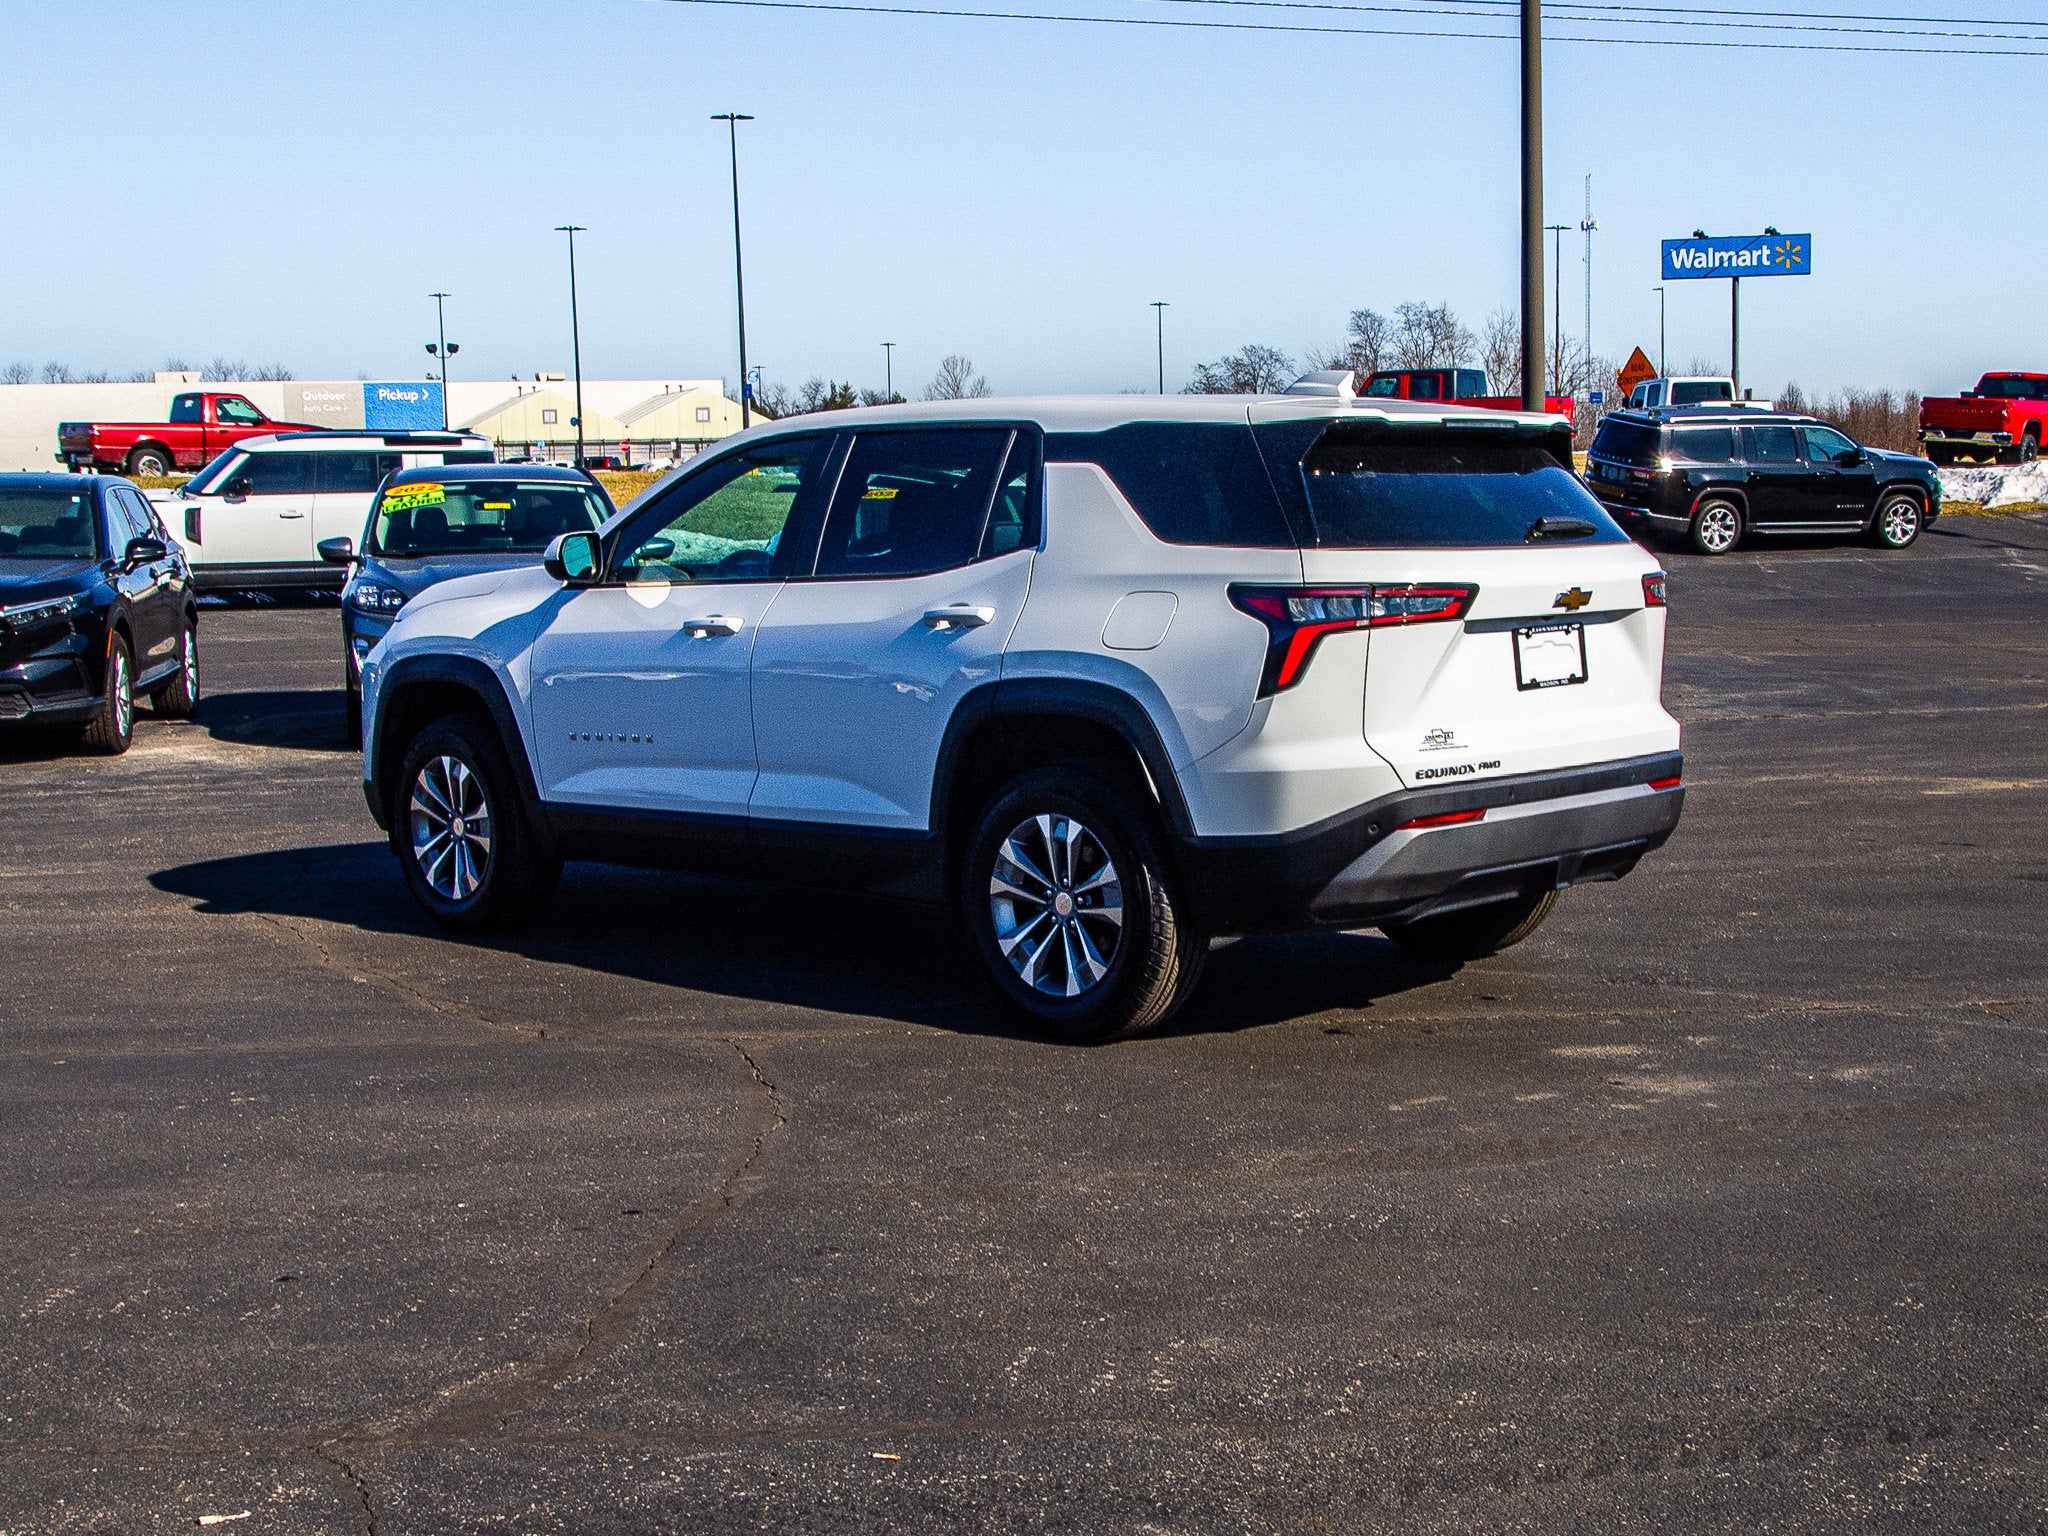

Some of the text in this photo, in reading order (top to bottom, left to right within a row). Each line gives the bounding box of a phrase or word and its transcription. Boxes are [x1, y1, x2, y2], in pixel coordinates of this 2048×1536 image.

[1671, 245, 1770, 269] Walmart
[302, 391, 345, 401] Outdoor
[378, 389, 419, 403] Pickup
[393, 484, 438, 495] 2022
[385, 496, 445, 512] LEATHER
[1415, 760, 1501, 780] EQUINOX AWD
